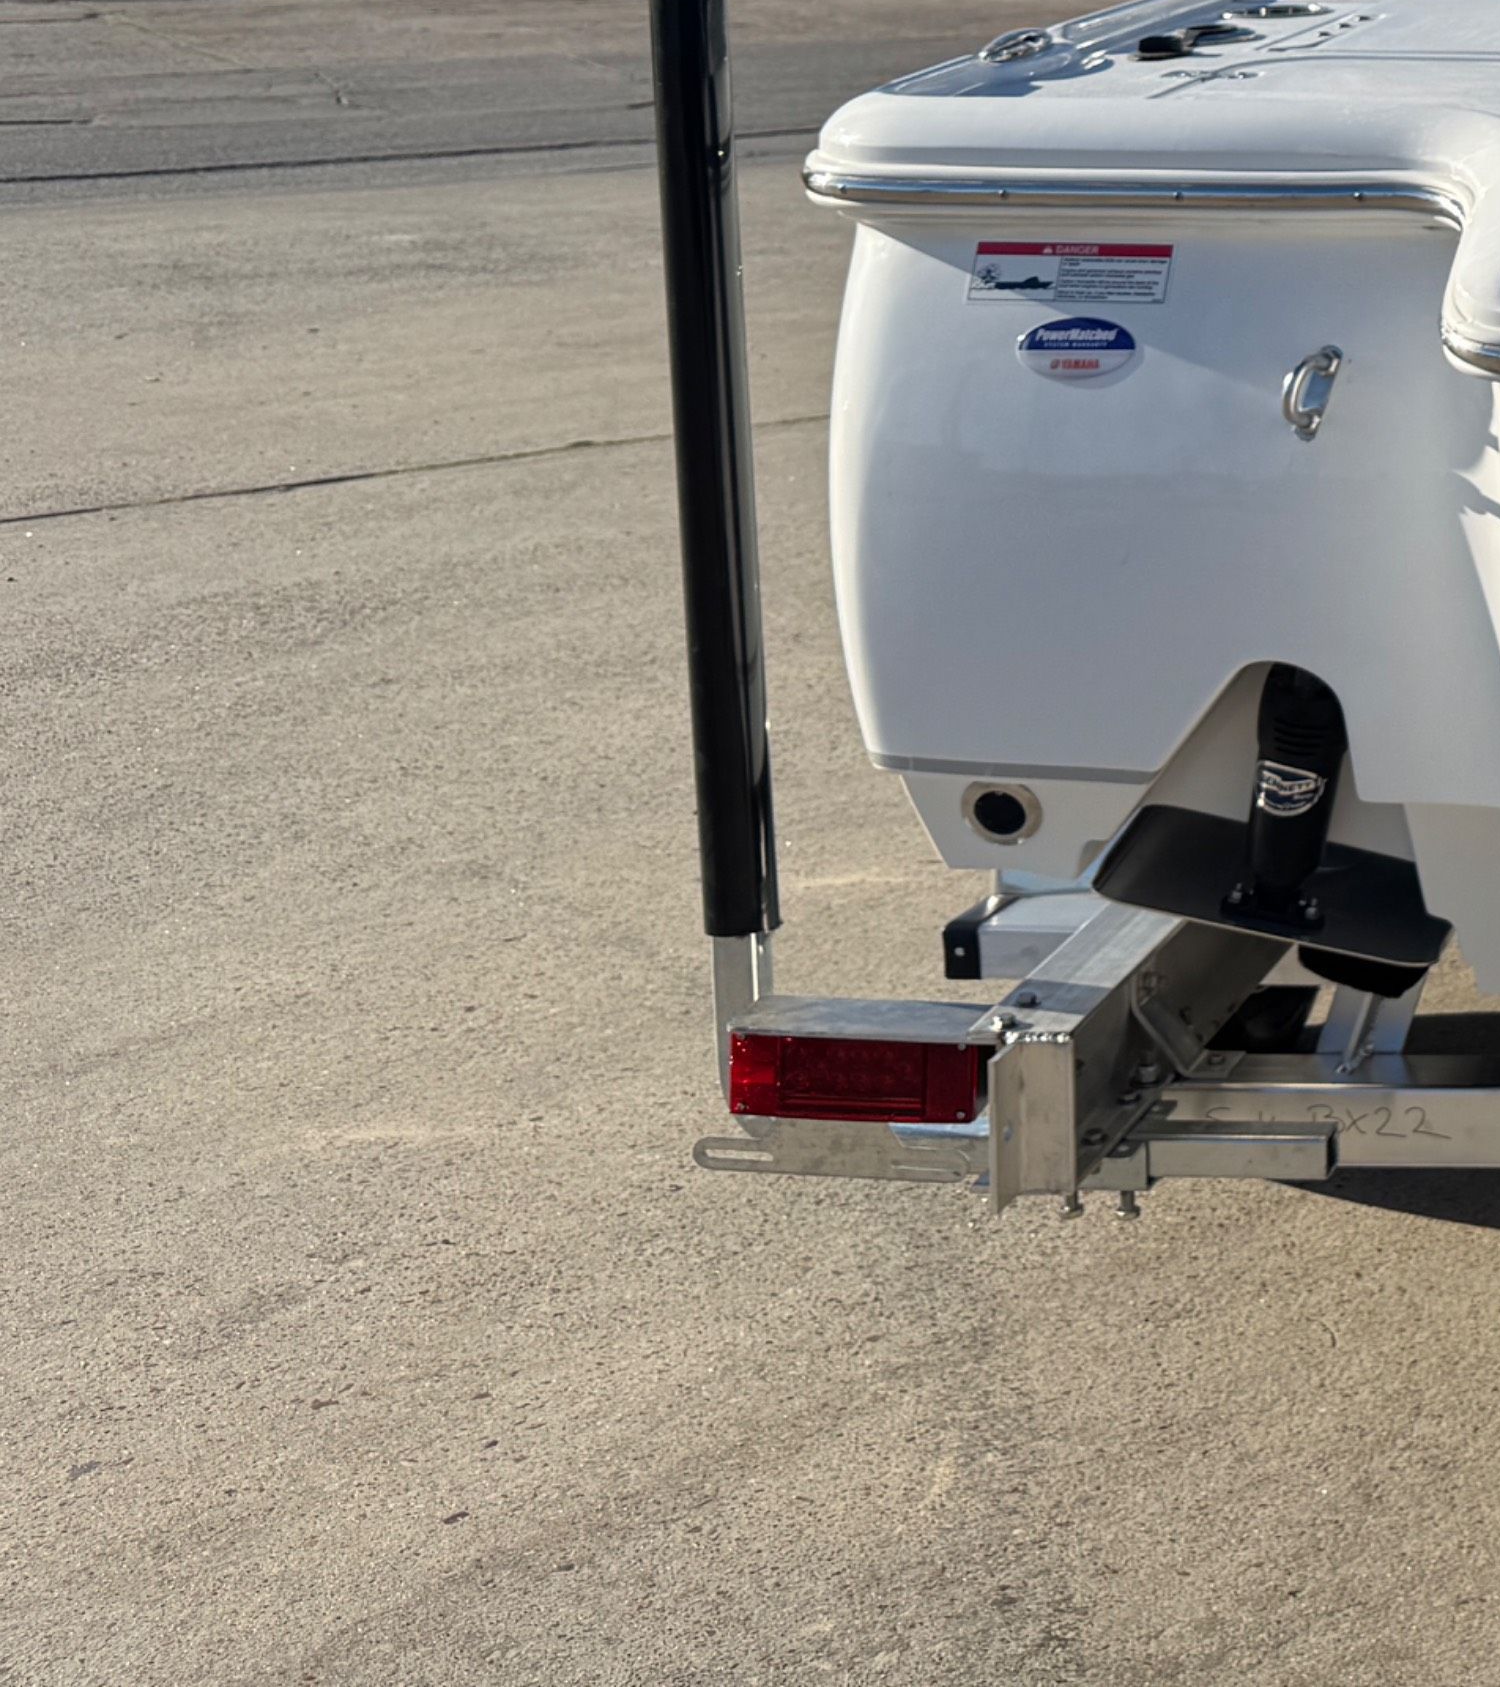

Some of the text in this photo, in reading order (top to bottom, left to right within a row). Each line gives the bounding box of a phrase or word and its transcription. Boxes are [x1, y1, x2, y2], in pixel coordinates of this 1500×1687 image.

[1054, 244, 1100, 255] DANGER
[1034, 327, 1119, 342] PowerMatched
[1061, 358, 1100, 370] YAMAHA
